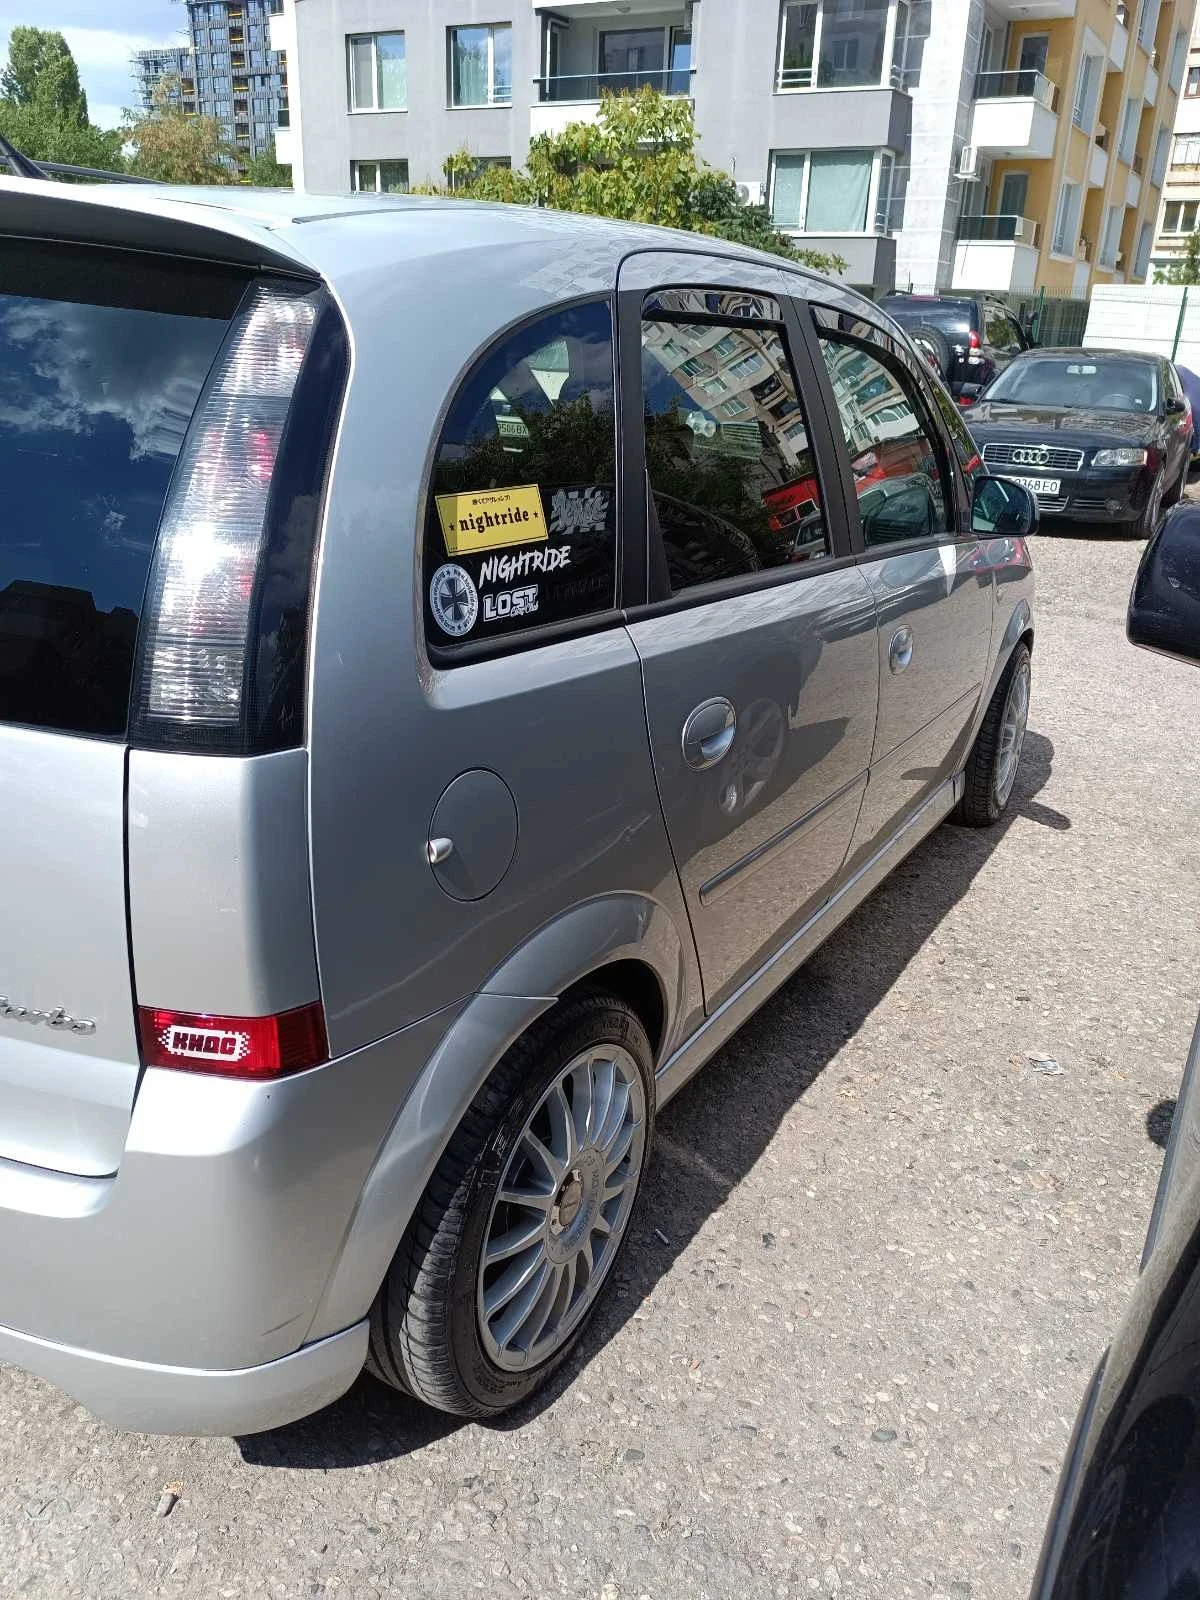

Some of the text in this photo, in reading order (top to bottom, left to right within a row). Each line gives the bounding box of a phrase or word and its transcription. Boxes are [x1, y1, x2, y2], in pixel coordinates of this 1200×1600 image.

[458, 506, 530, 533] nightride
[478, 545, 572, 590] NIGHTRIDE
[484, 585, 538, 621] LOST
